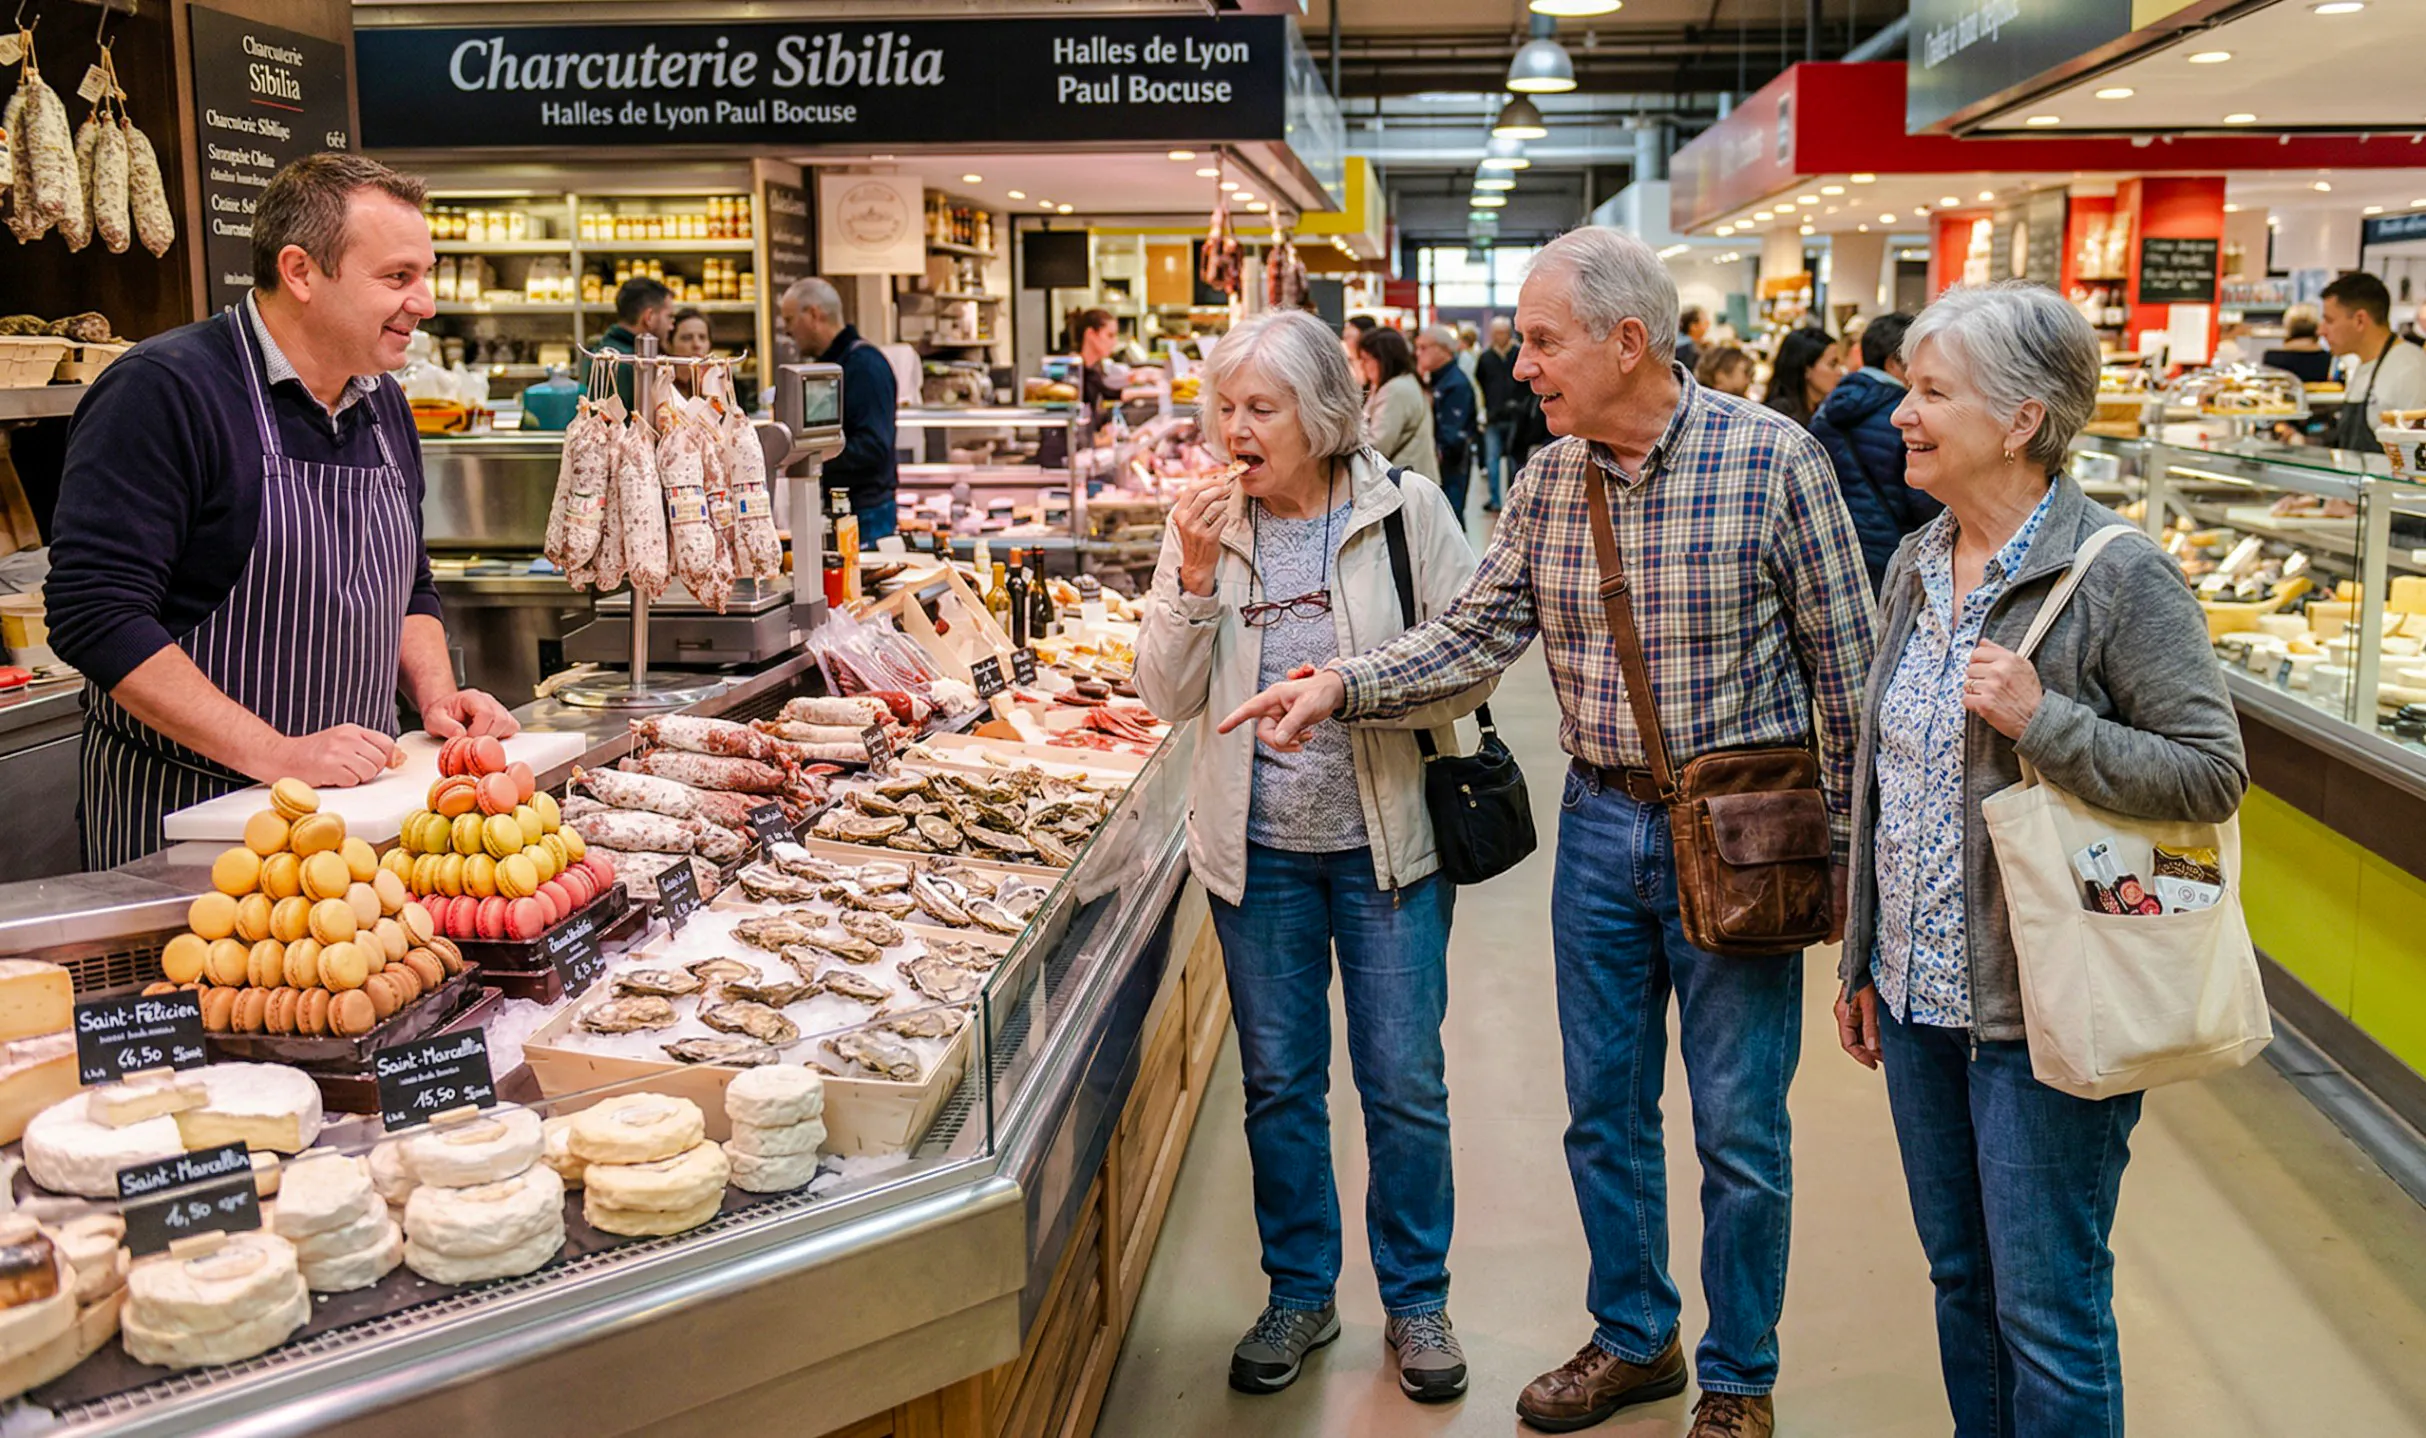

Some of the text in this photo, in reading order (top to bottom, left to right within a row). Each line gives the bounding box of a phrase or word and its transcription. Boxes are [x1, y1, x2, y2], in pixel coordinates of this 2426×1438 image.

[242, 35, 303, 67] Charcuterie
[449, 32, 945, 91] Charcuterie Sibilia
[1054, 35, 1249, 71] Halles de Lyon
[249, 63, 302, 100] Sibilia
[1058, 74, 1232, 103] Paul Bocuse
[541, 100, 857, 130] Halles de Lyon Paul Bocuse
[80, 1001, 199, 1032] Saint-Félicien
